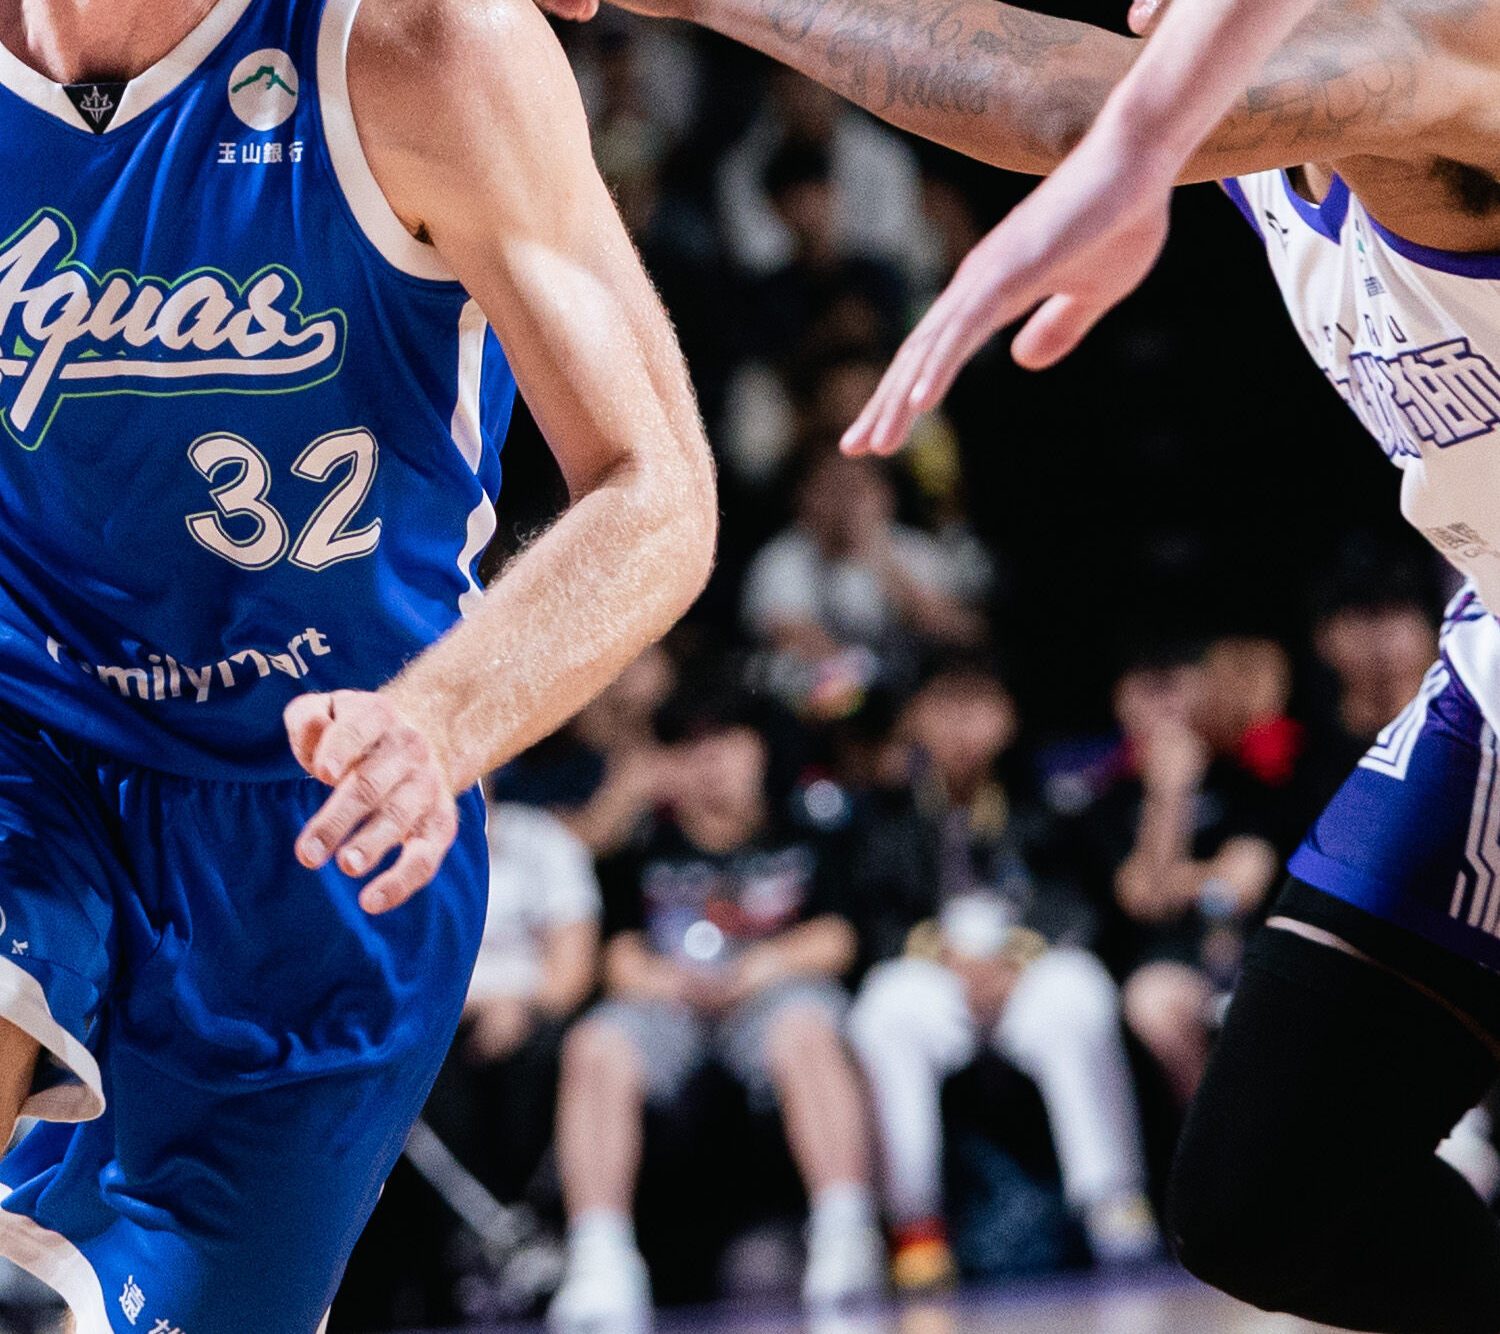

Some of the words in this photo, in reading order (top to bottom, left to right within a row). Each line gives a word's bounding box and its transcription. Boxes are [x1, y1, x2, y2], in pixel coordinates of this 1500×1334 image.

[217, 140, 304, 164] 玉山銀行
[186, 426, 382, 572] 32
